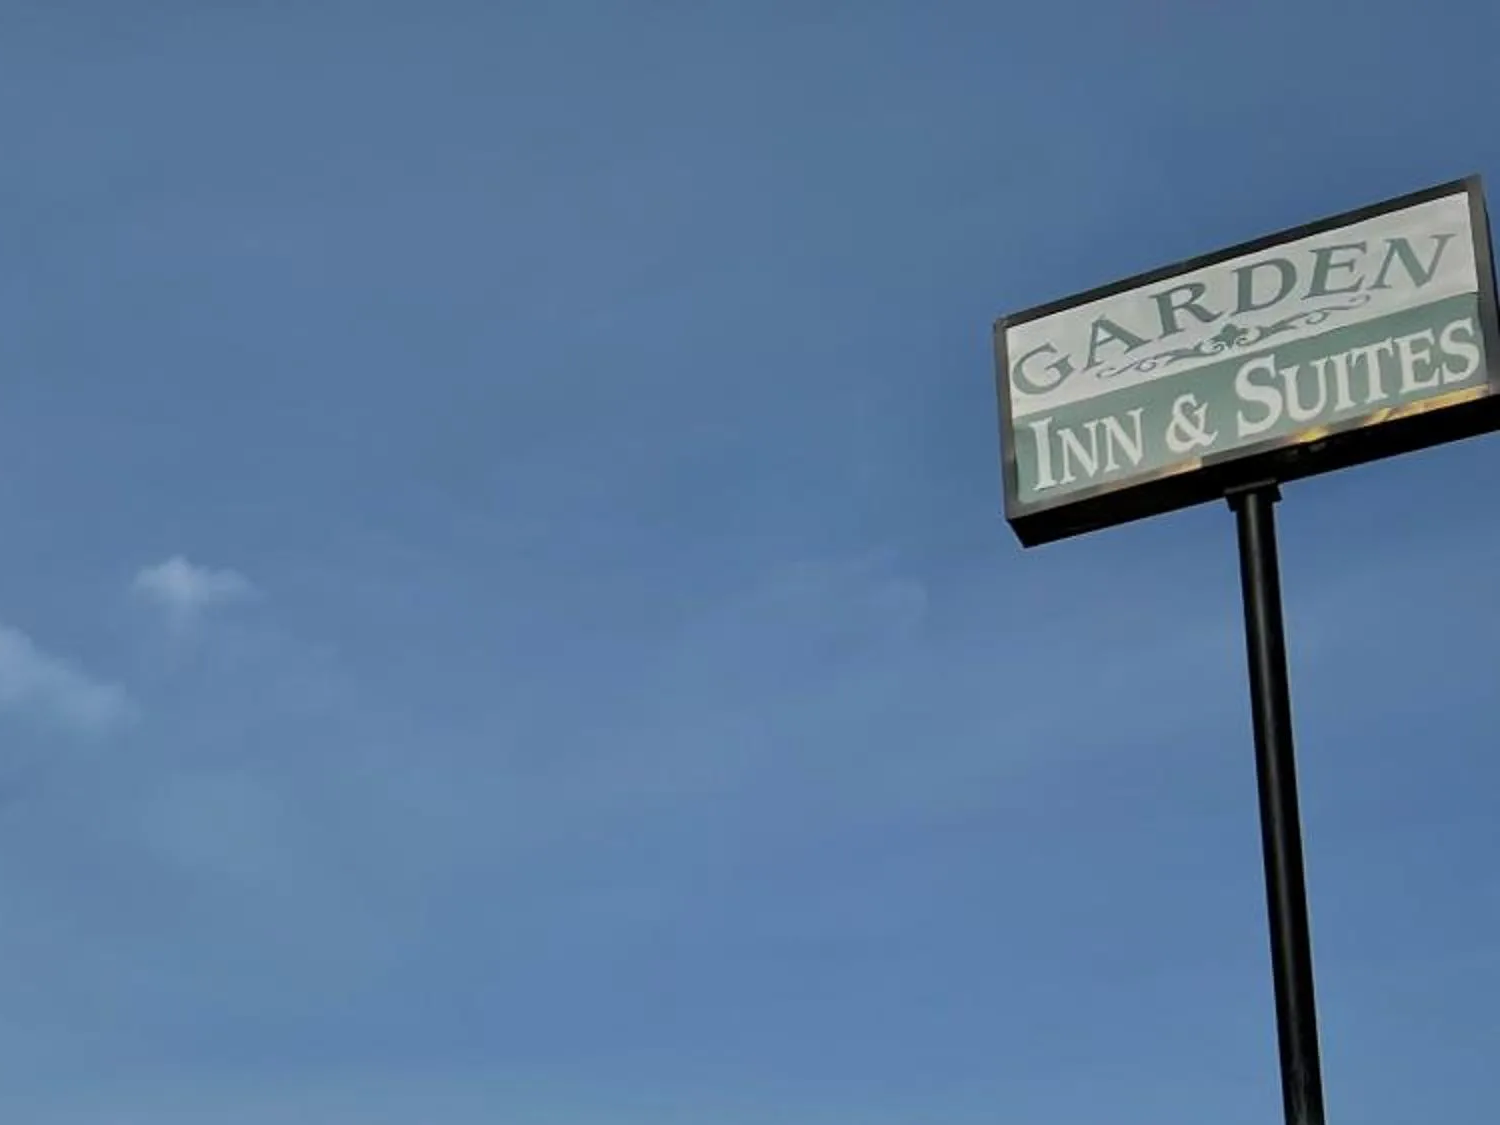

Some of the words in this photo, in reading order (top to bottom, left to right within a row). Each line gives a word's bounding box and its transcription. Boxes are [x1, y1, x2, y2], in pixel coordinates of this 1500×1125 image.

[1011, 233, 1455, 397] GARDEN
[1030, 408, 1143, 492] INN
[1164, 392, 1219, 454] &
[1233, 317, 1481, 441] SUITES
